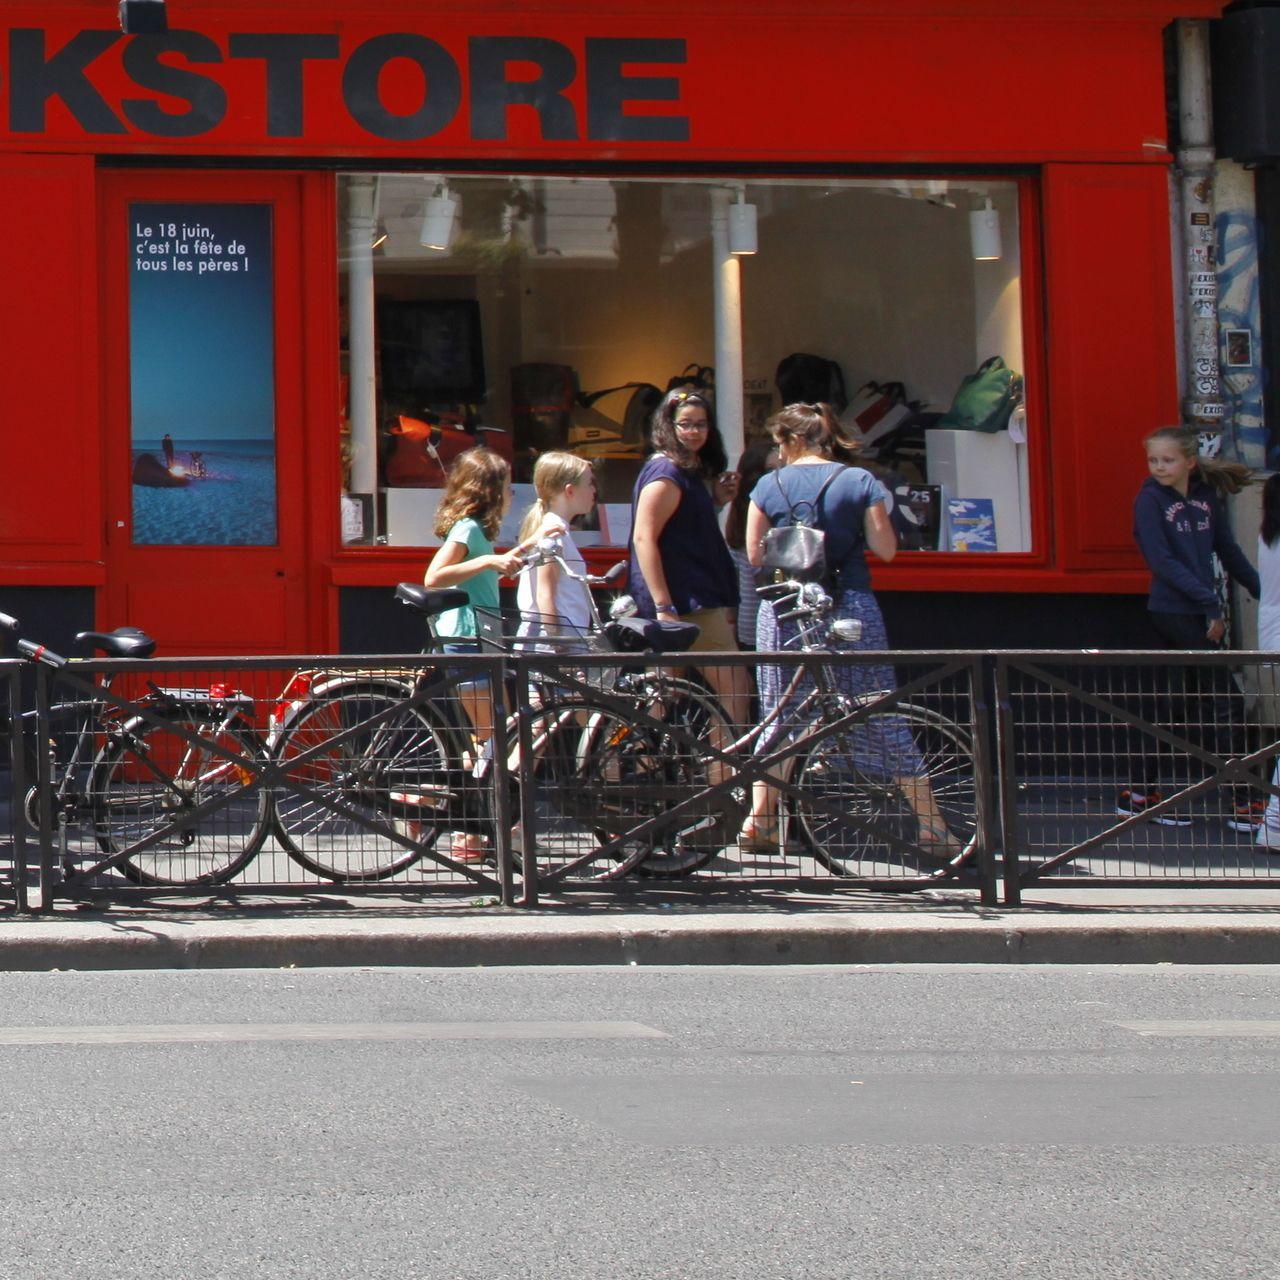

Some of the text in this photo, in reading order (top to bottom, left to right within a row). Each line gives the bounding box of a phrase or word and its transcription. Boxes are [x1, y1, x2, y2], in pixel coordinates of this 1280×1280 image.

[136, 223, 215, 240] Le 18 juin,
[136, 239, 246, 254] c'est la fête de
[136, 258, 168, 271] tous
[173, 256, 193, 271] les
[198, 258, 238, 275] pères
[911, 490, 930, 503] 25
